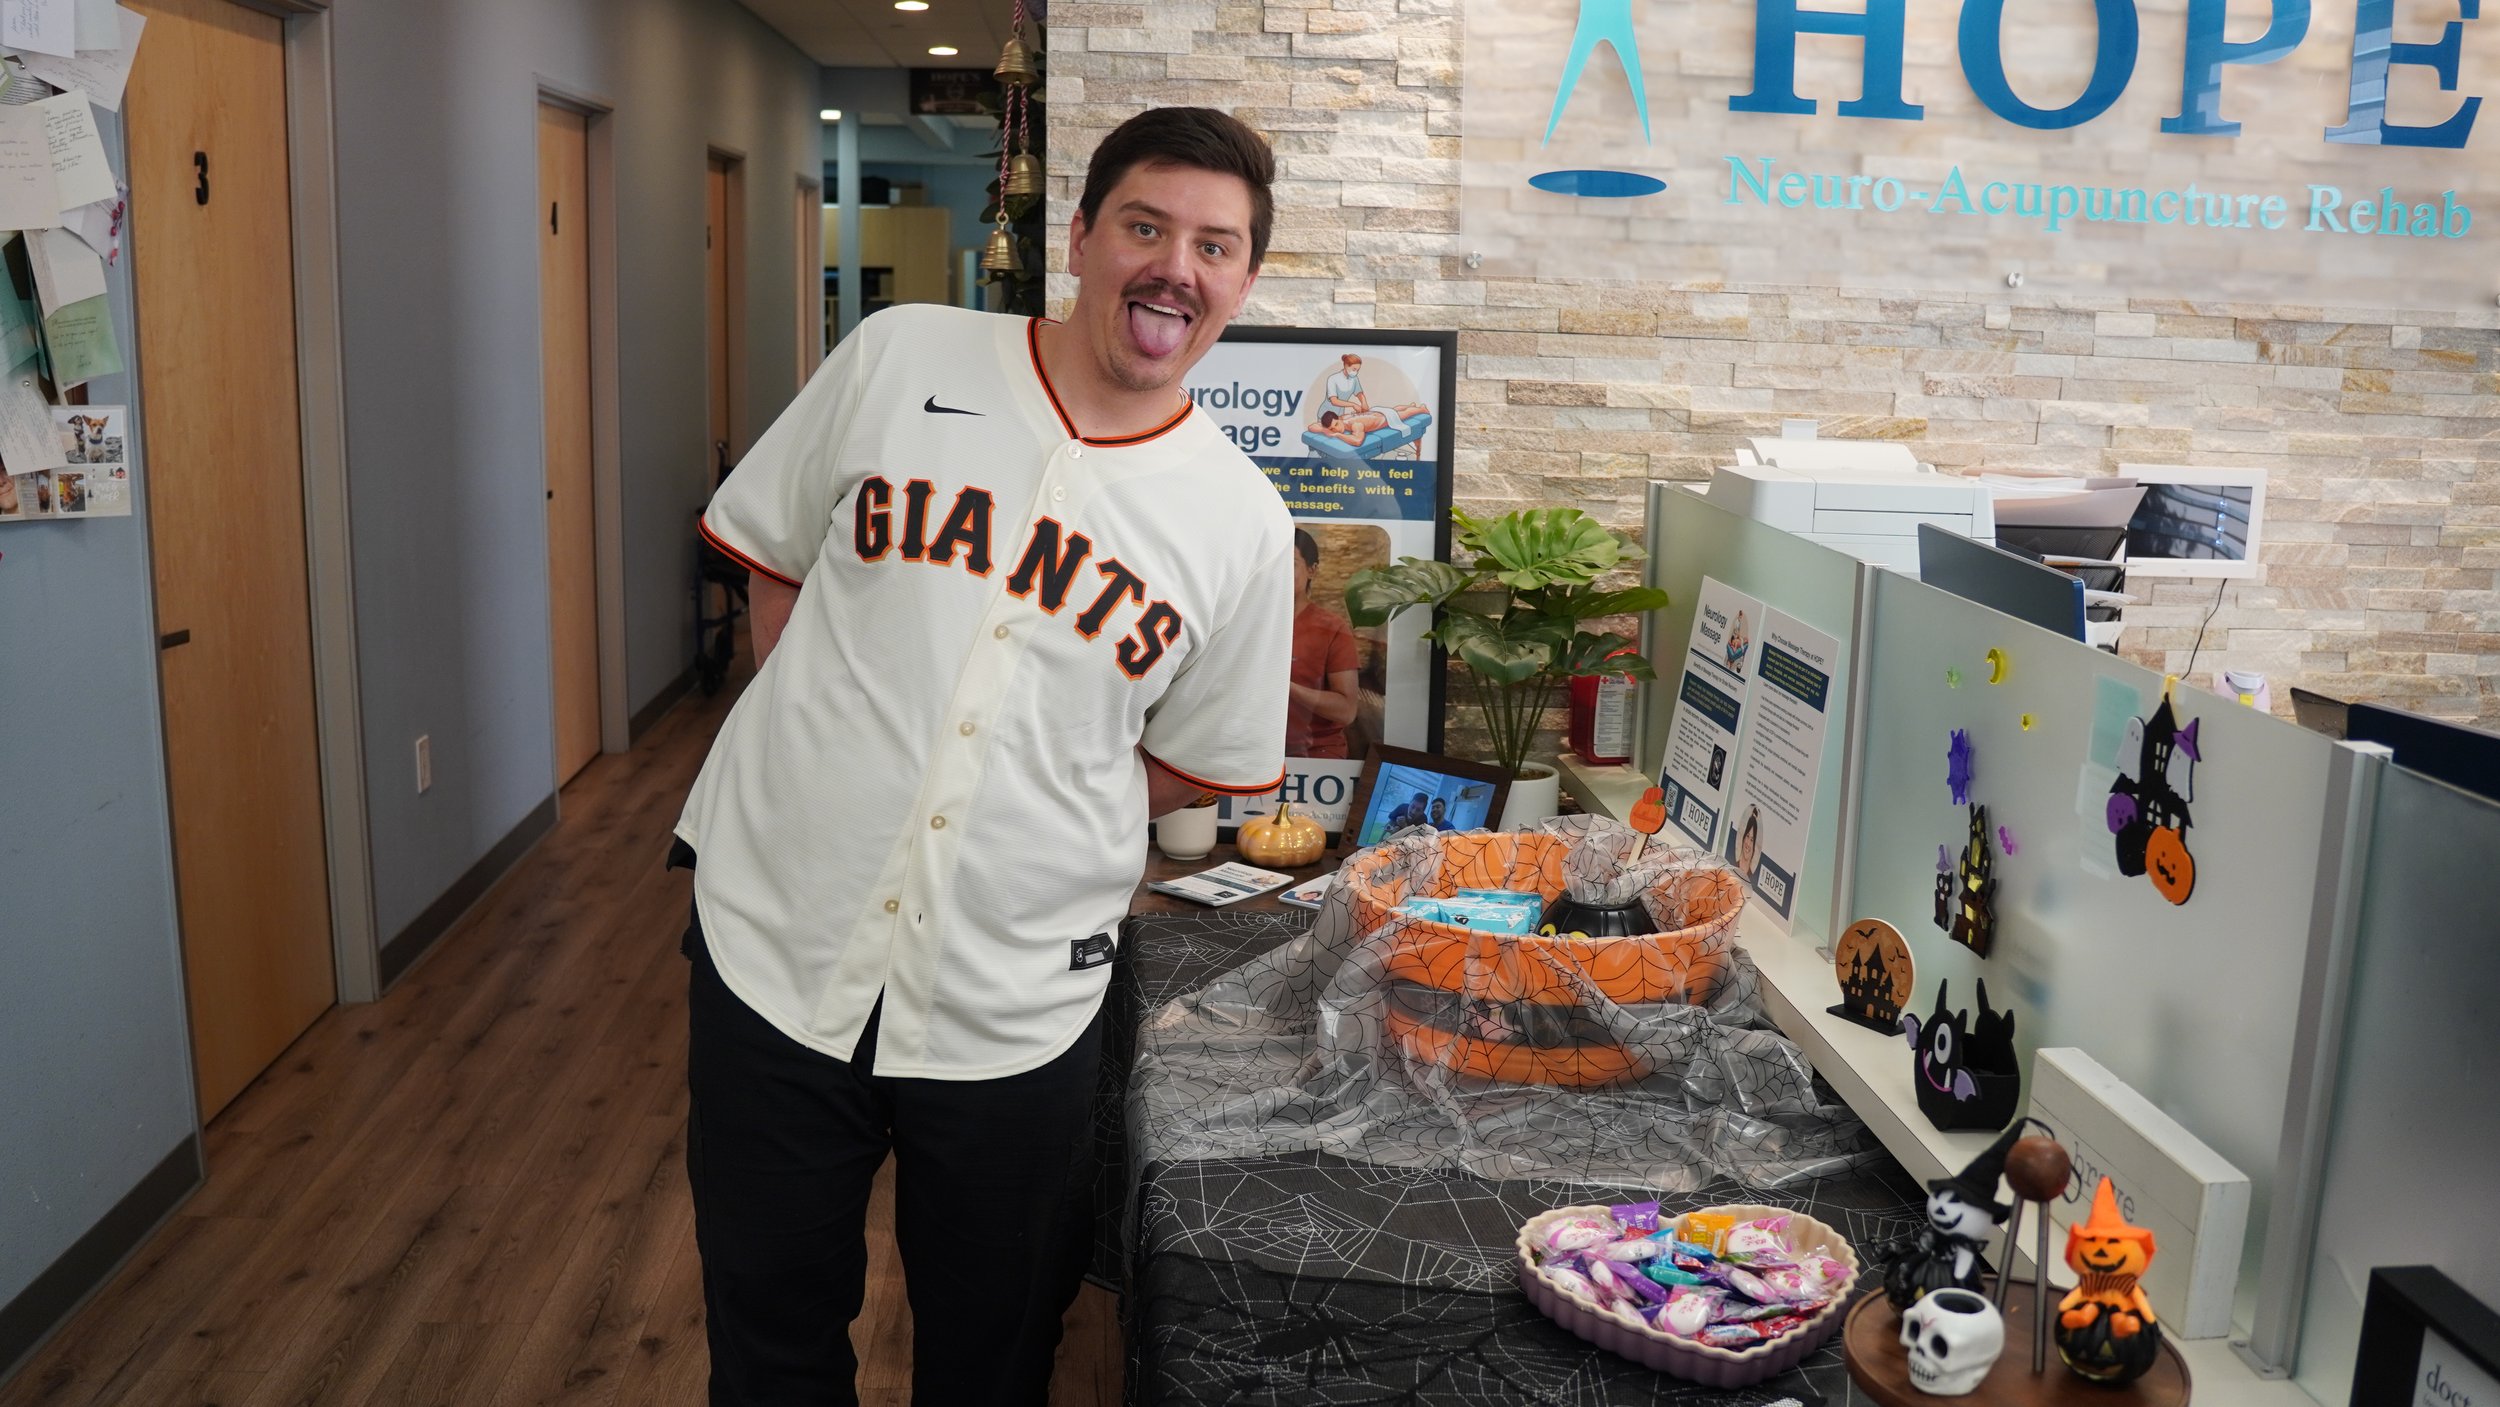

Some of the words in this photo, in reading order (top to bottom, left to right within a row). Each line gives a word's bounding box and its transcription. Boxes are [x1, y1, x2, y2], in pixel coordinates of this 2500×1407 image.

[1729, 0, 2481, 149] HOPE
[193, 150, 209, 206] 3
[1723, 156, 2287, 233] Neuro-Acupuncture
[2304, 184, 2473, 239] Rehab
[1220, 425, 1281, 453] age
[1262, 467, 1281, 476] we
[1289, 467, 1313, 477] can
[1321, 467, 1349, 479] help
[1357, 469, 1380, 480] you
[1389, 468, 1413, 479] feel
[1274, 483, 1290, 492] he
[1300, 483, 1355, 494] benefits
[1365, 485, 1395, 495] with
[1404, 488, 1412, 496] a
[1285, 500, 1344, 512] massage.
[854, 476, 1183, 681] GIANTS
[1704, 604, 1728, 629] Neurology
[1700, 621, 1721, 645] Massage
[1787, 640, 1799, 654] Massage
[1688, 804, 1710, 832] HOPE
[1764, 871, 1784, 897] HOPE
